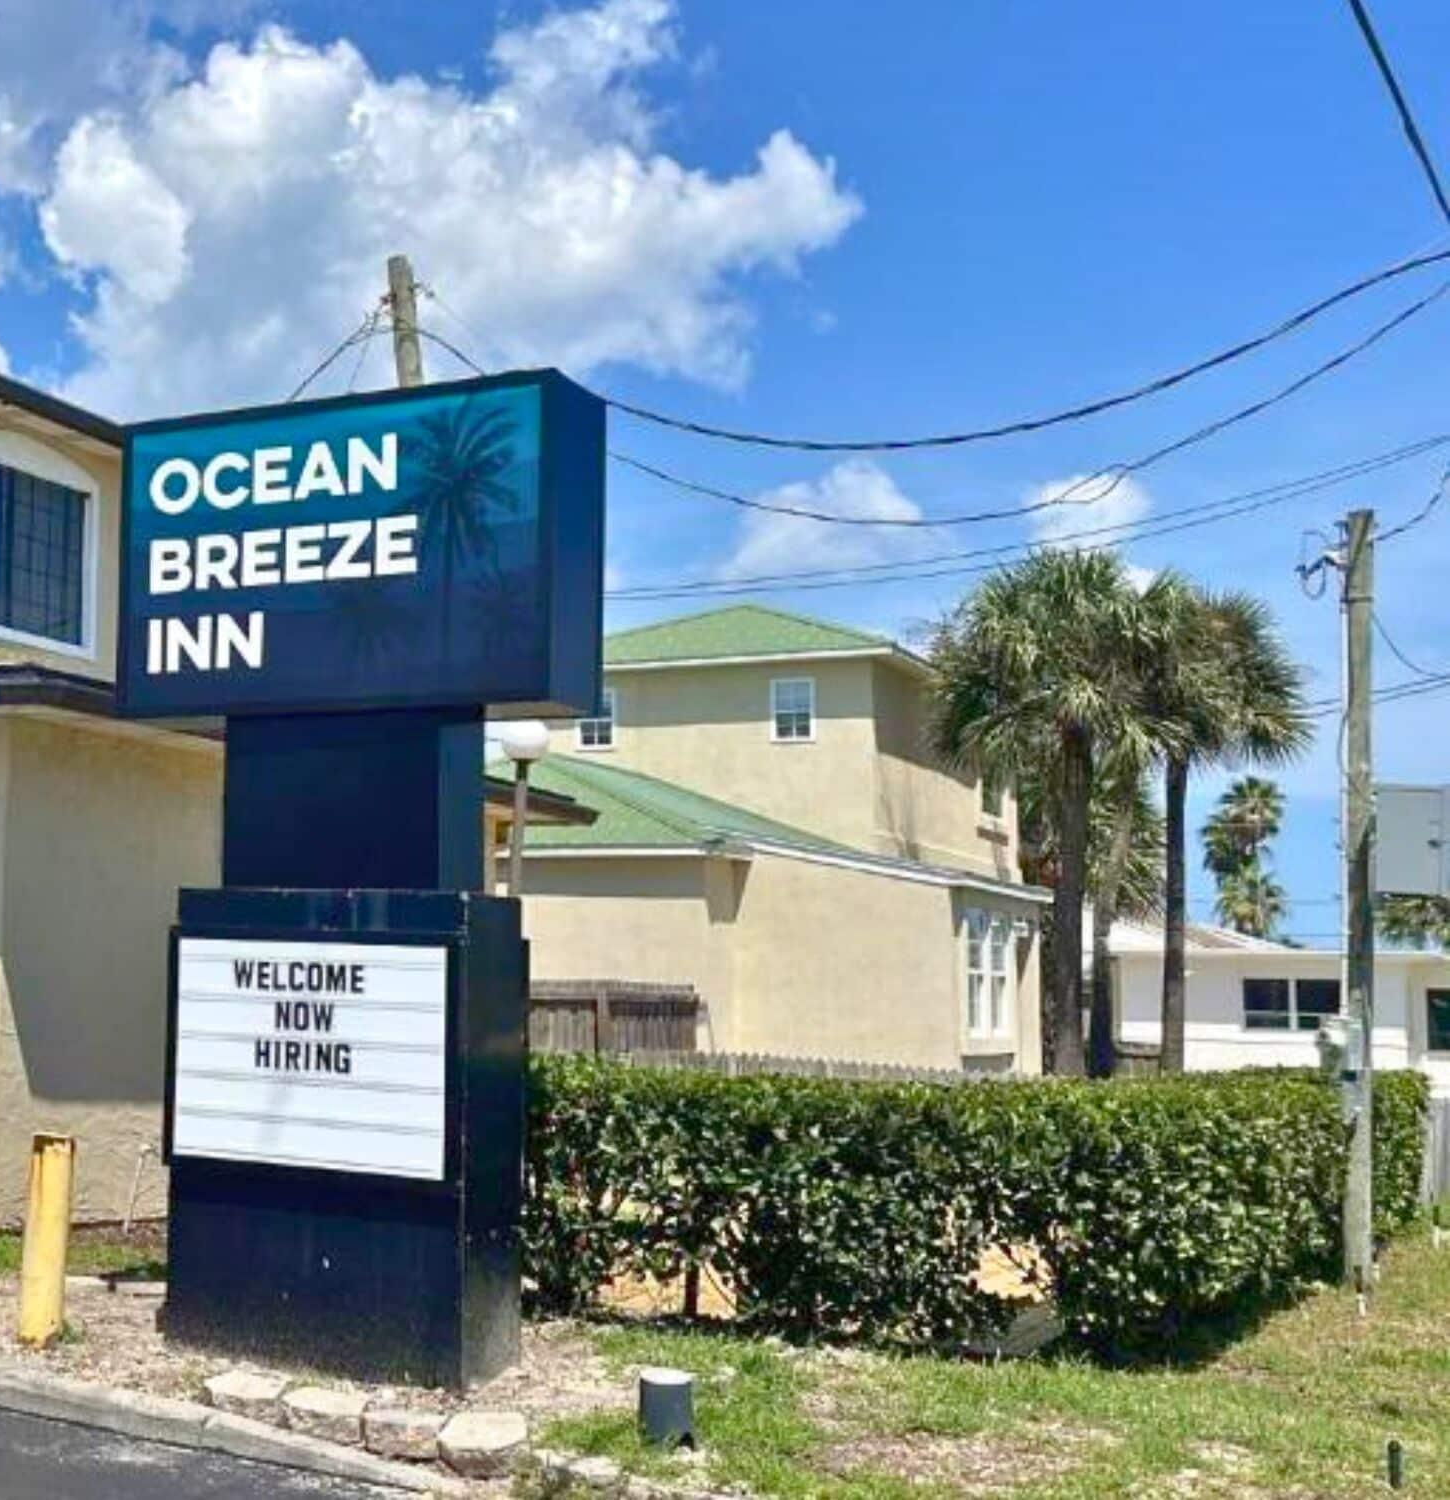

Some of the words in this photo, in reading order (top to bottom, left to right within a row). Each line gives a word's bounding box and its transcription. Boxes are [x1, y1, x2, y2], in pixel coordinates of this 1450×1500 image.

[150, 433, 398, 515] OCEAN
[149, 514, 418, 596] BREEZE
[146, 611, 264, 675] INN
[234, 959, 365, 994] WELCOME
[274, 1001, 335, 1033] NOW
[254, 1038, 352, 1075] HIRING
